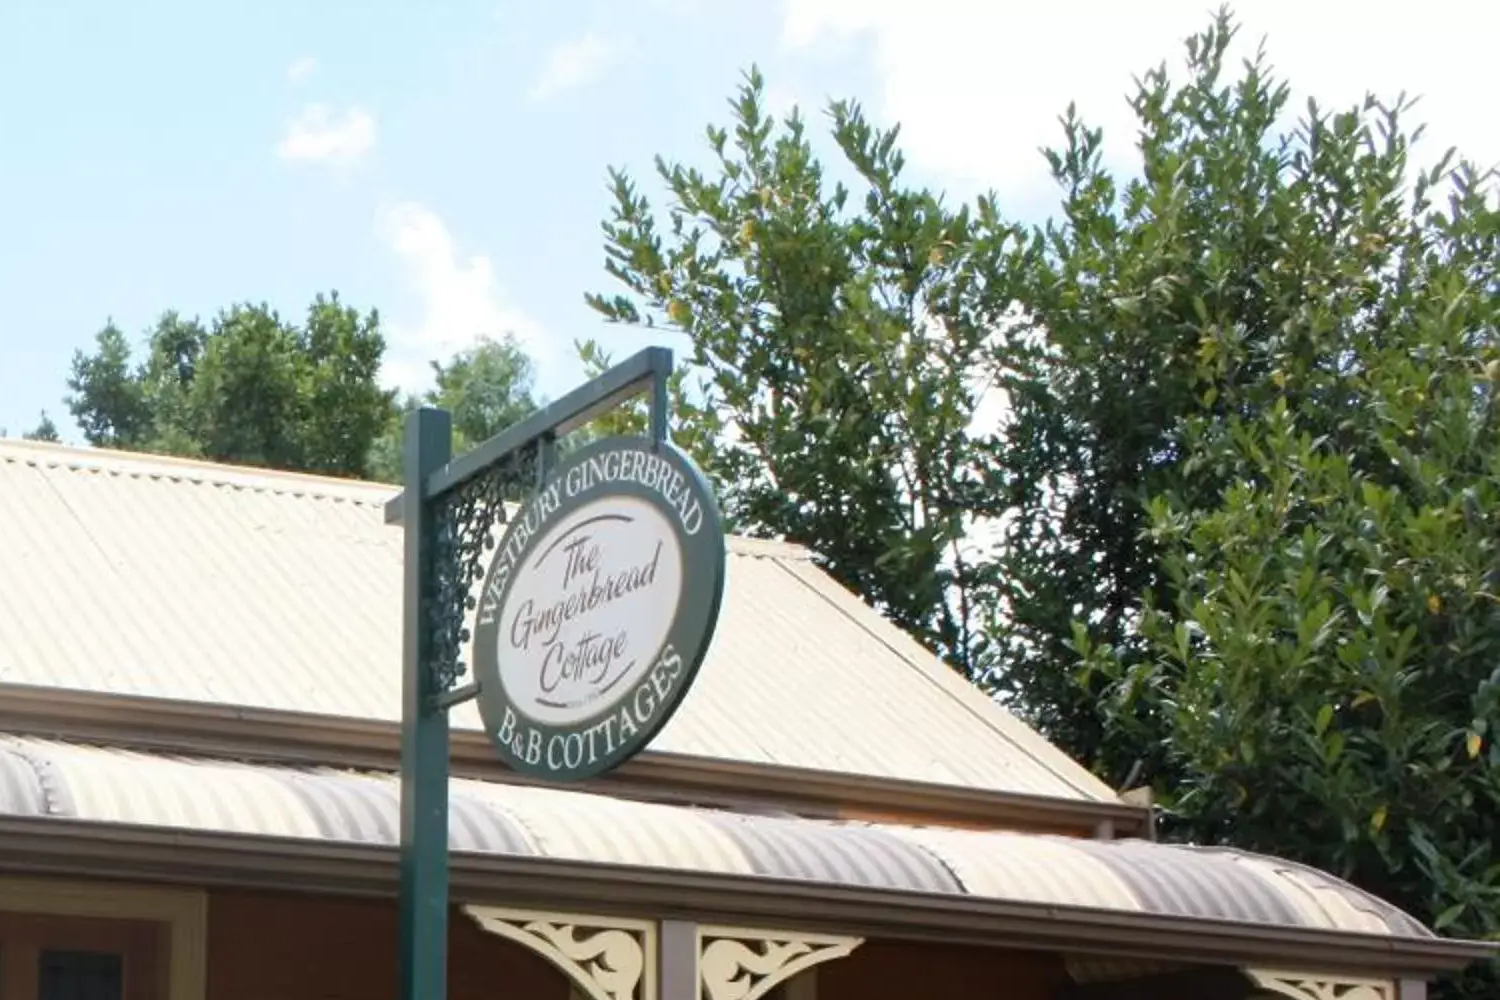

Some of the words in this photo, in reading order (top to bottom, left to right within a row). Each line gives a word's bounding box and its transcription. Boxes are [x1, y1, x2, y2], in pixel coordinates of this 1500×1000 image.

[480, 478, 564, 625] WESTBURY
[566, 450, 703, 536] GINGERBREAD
[564, 535, 599, 590] The
[510, 539, 663, 650] Gingerbread
[498, 706, 543, 765] B&B
[547, 644, 682, 770] COTTAGES
[540, 629, 627, 693] Cottage
